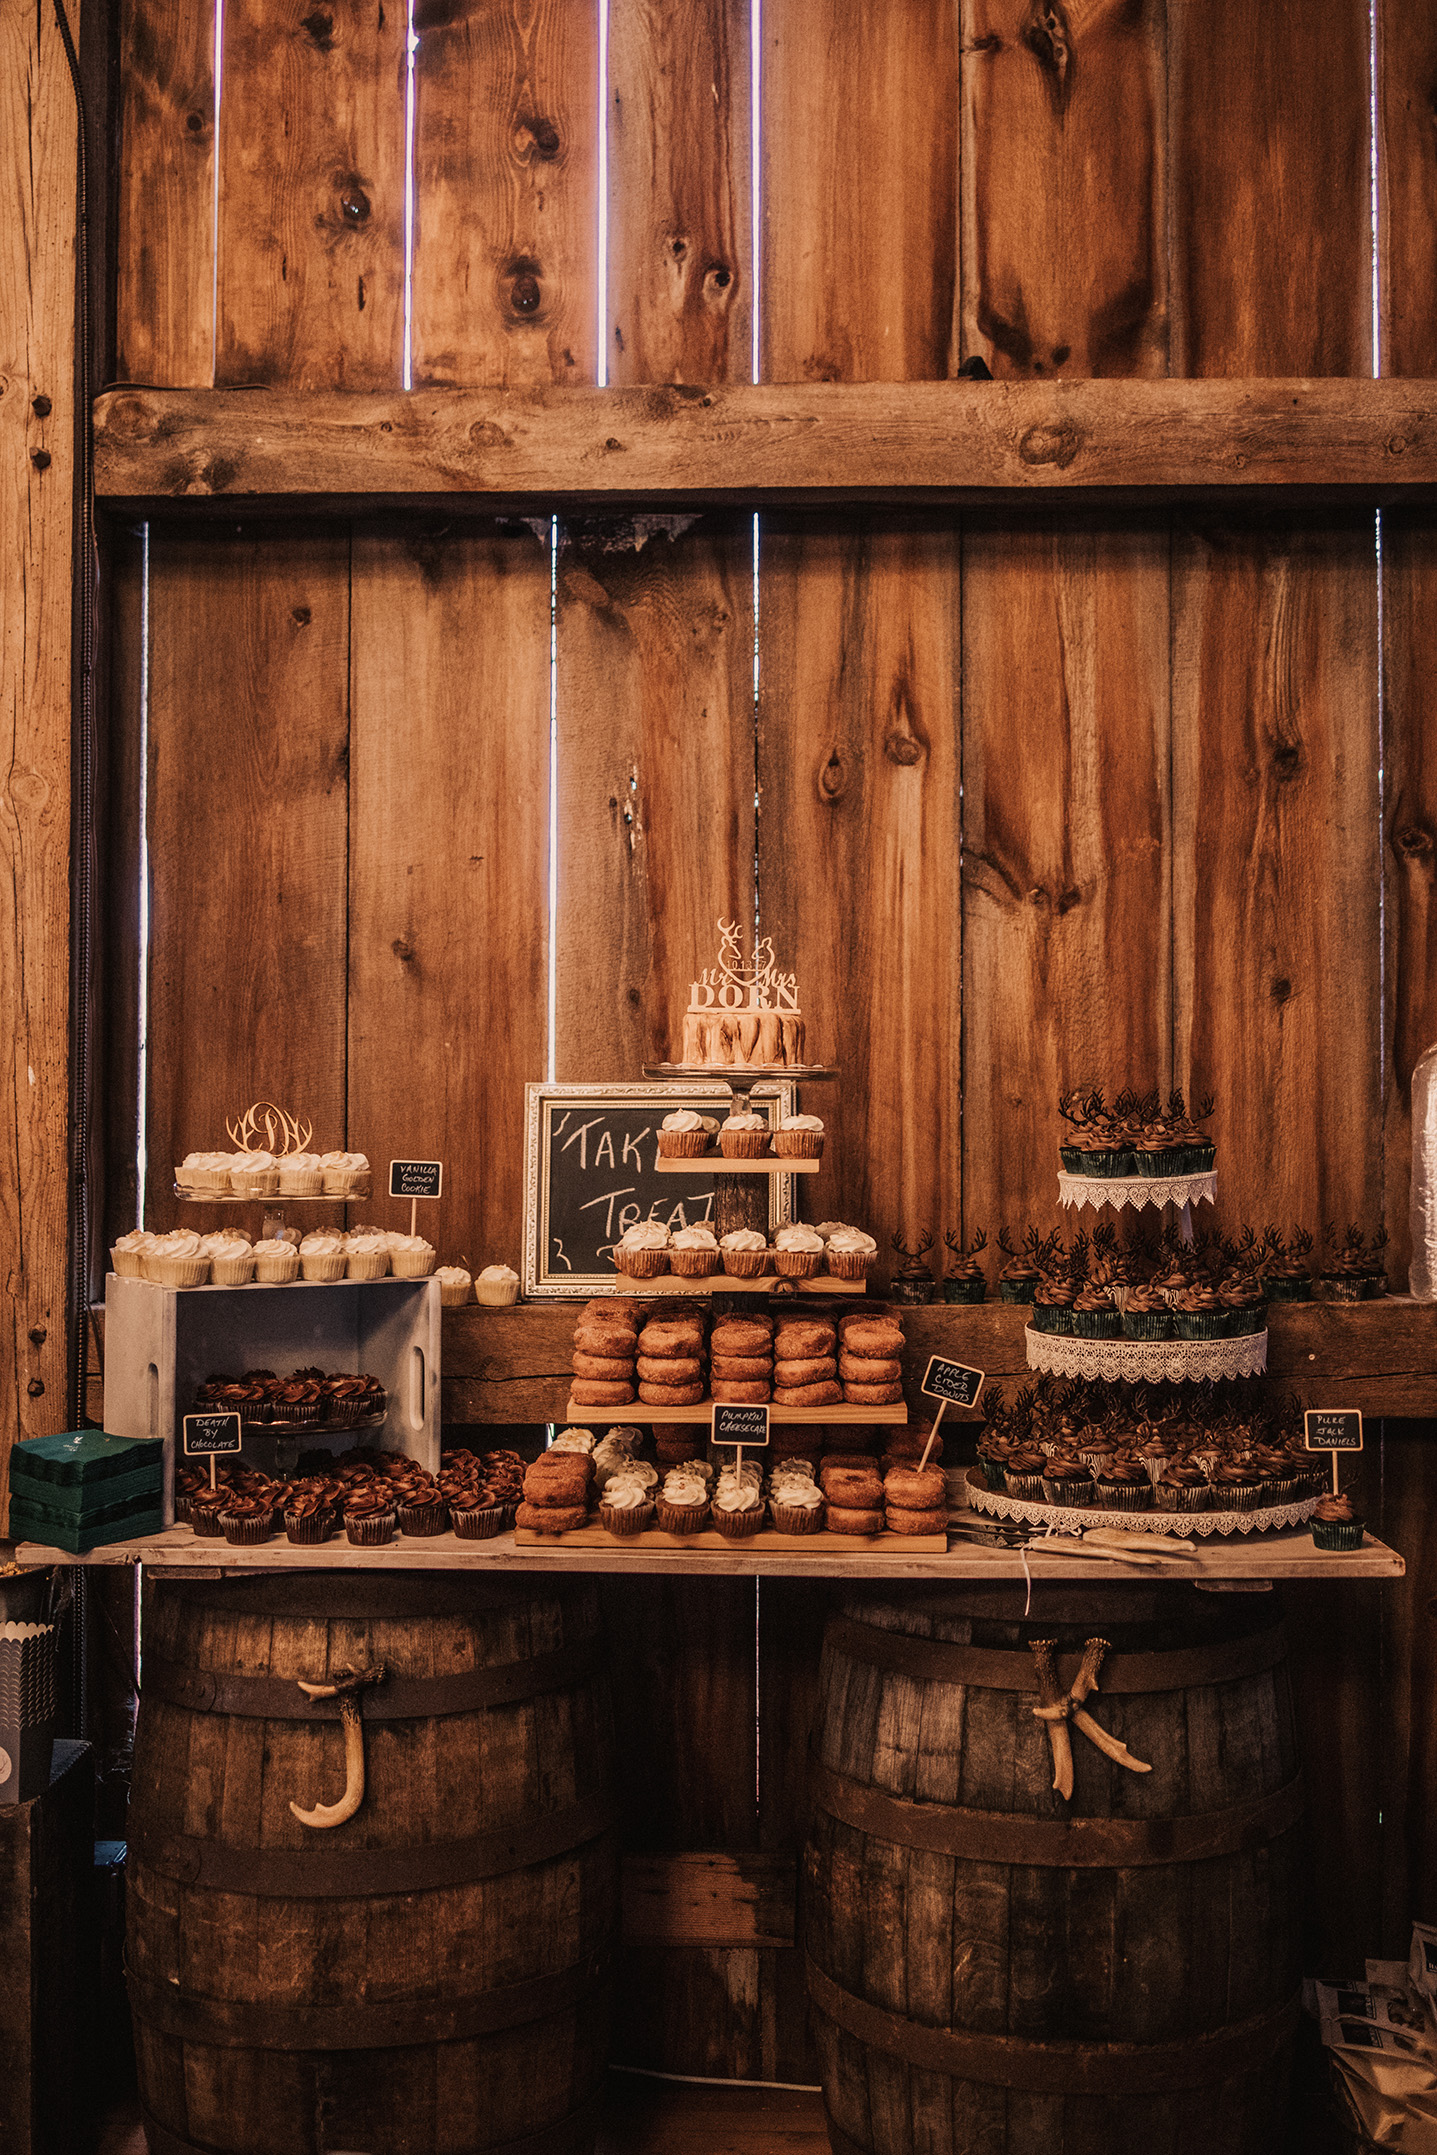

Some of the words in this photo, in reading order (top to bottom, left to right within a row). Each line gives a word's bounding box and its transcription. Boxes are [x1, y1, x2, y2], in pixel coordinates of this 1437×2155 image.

[697, 967, 733, 987] Mr
[760, 967, 797, 987] Mrs
[688, 984, 800, 1009] DORN
[561, 1117, 660, 1173] TAK
[400, 1165, 438, 1176] VANILLA
[401, 1183, 431, 1194] COOKIE
[937, 1363, 972, 1381] APPLE
[935, 1374, 968, 1392] CIDER
[931, 1384, 970, 1402] DONUTS
[721, 1410, 764, 1421] PUMPKIN
[1316, 1415, 1346, 1424] PURE
[195, 1416, 230, 1427] DEATH
[719, 1421, 766, 1435] CHEESECAKE
[1316, 1428, 1345, 1437] JACK
[202, 1429, 218, 1439] BY
[190, 1439, 236, 1450] CHOCOLATE
[1313, 1437, 1356, 1446] DANIELS
